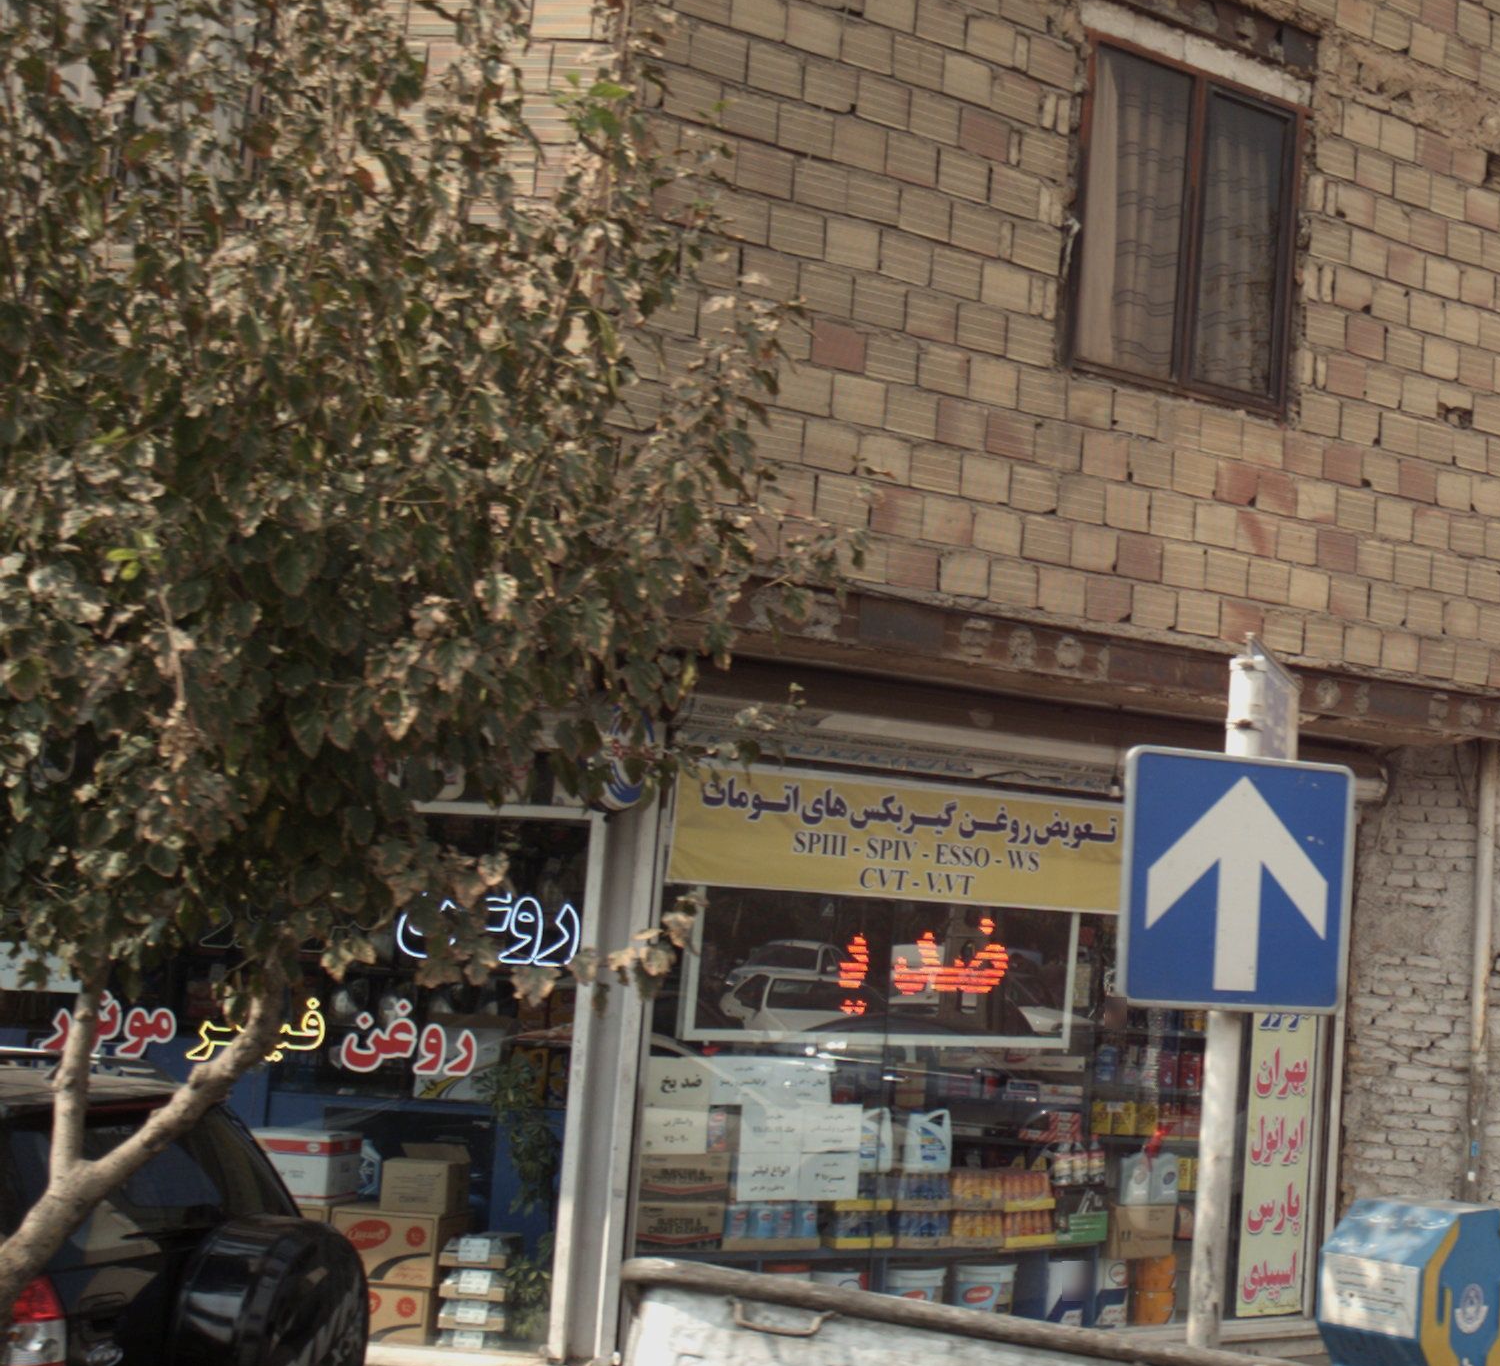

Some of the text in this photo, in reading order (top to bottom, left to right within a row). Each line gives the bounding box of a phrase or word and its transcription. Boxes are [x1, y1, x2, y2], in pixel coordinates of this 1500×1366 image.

[801, 788, 848, 825] های
[849, 795, 958, 835] گیربکس
[958, 805, 1032, 846] روغن
[1034, 811, 1118, 849] تعویض
[793, 831, 847, 857] SPIII
[866, 838, 918, 862] SPIV
[934, 843, 990, 868] ESSO
[1008, 849, 1040, 872] WS
[860, 867, 909, 892] CVT
[341, 1000, 478, 1075] روغن
[660, 1076, 677, 1094] یخ
[681, 1074, 703, 1089] ضد
[1251, 1116, 1305, 1165] ایرانول
[1247, 1182, 1301, 1233] پارس
[1242, 1250, 1298, 1303] اسپیدی
